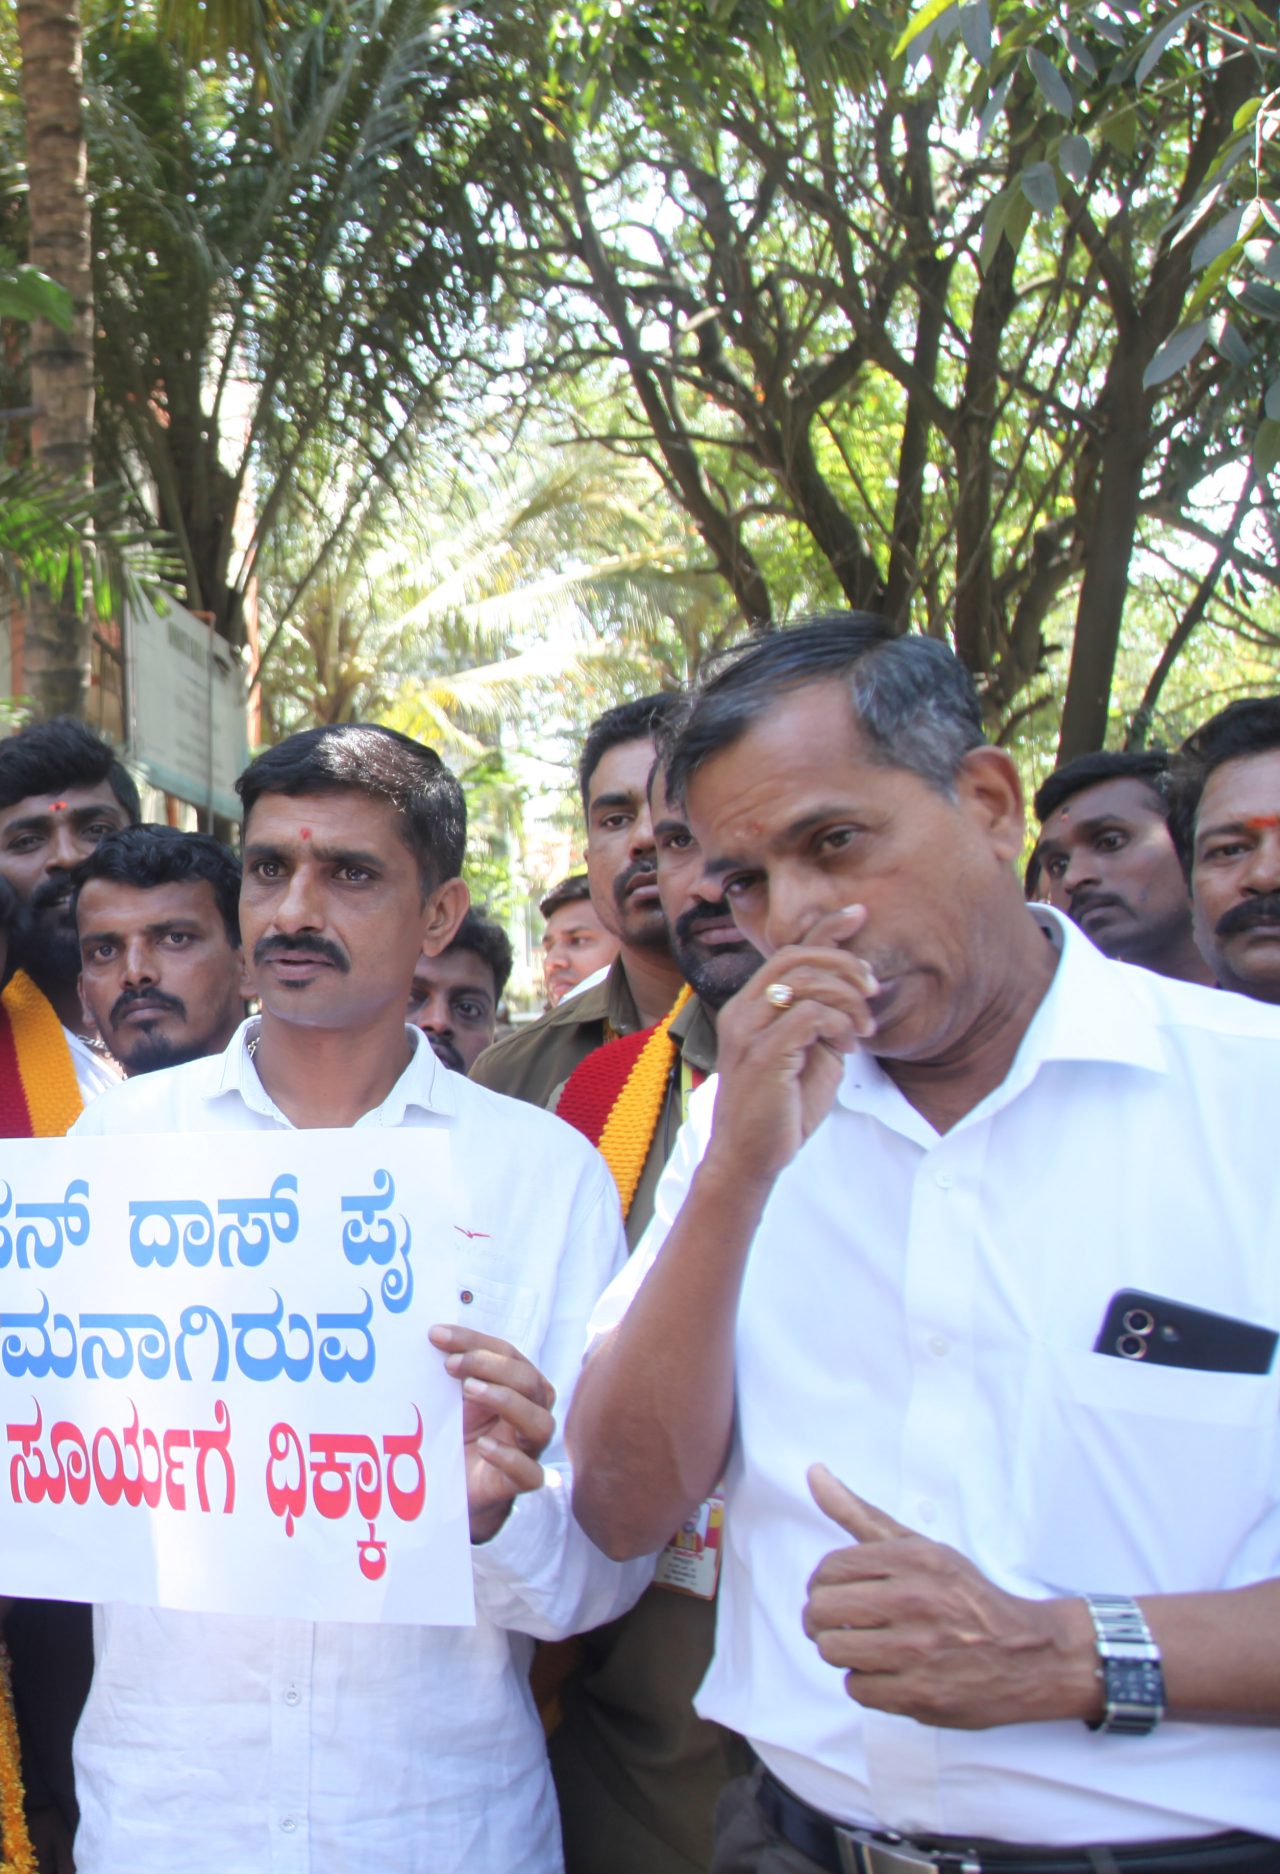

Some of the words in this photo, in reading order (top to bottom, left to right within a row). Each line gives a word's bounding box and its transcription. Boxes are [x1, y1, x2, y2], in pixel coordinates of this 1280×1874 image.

[128, 1172, 300, 1271] ದಾಸ್
[340, 1168, 415, 1314] ಪೈ
[6, 1394, 237, 1515] ಸೂರ್ಯಗೆ
[265, 1402, 427, 1581] ಧಿಕ್ಕಾರ
